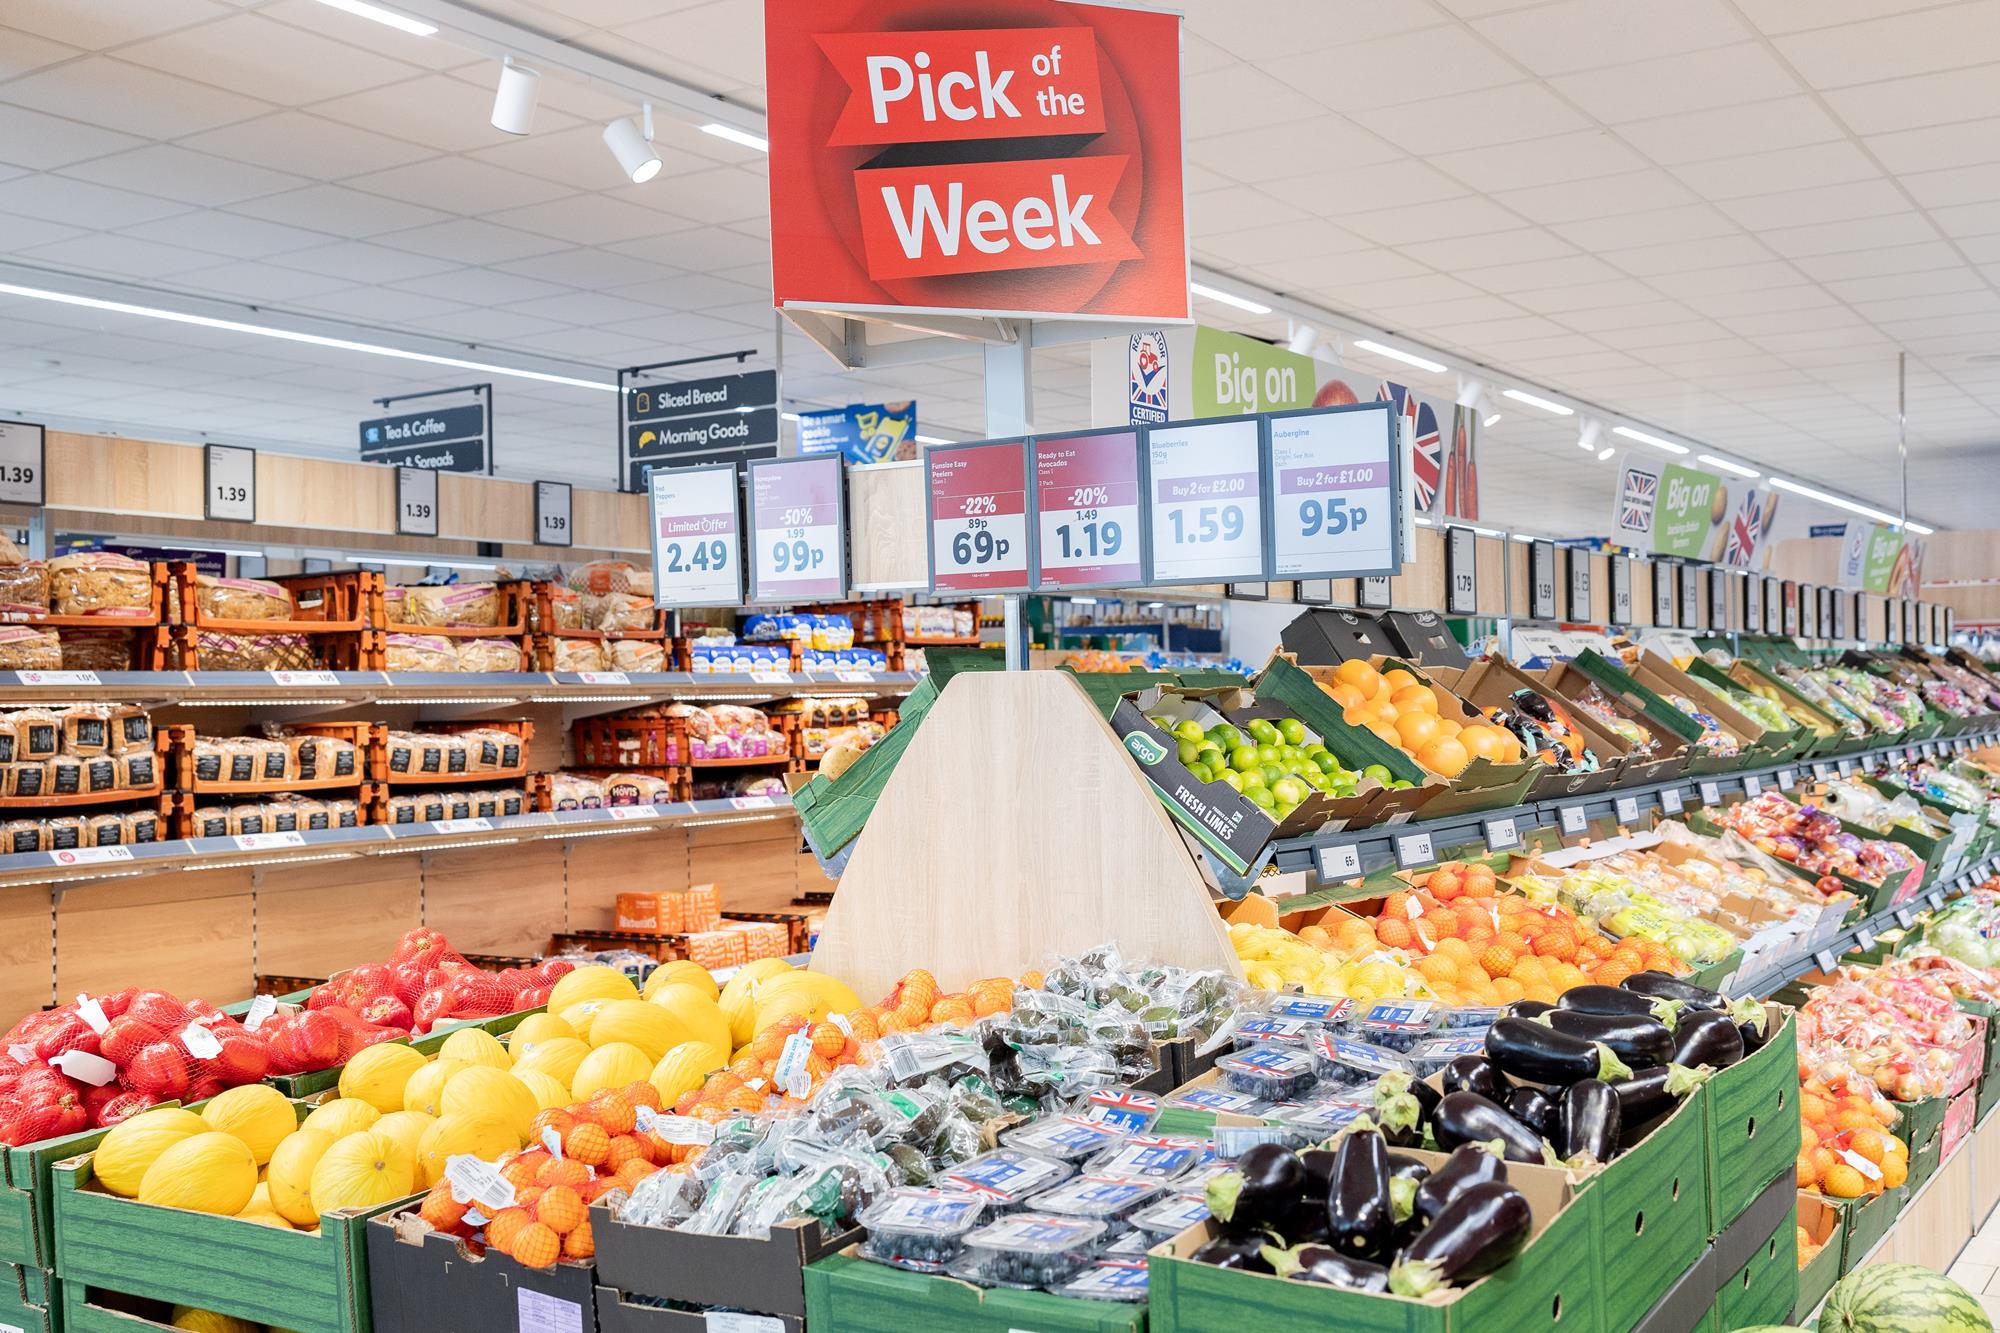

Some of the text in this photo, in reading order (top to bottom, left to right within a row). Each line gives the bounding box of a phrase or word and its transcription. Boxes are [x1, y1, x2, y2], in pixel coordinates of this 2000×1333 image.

[866, 45, 1062, 124] Pick of
[1036, 87, 1086, 117] the
[881, 174, 1102, 259] Week
[1215, 352, 1297, 414] Big on
[658, 385, 728, 409] Sliced Bread
[1132, 406, 1166, 423] CERTIFIED
[384, 419, 446, 440] Tea & Coffee
[659, 421, 749, 446] Morning Goods
[1273, 429, 1310, 439] Aubergine
[1152, 440, 1188, 449] Blueberries
[415, 451, 455, 469] Spreads
[1038, 451, 1057, 460] Ready
[1038, 460, 1067, 468] Avocados
[1152, 451, 1167, 459] 150g
[0, 466, 34, 483] 1.39
[932, 461, 967, 470] Funsize Easy
[932, 470, 953, 478] Peelers
[1296, 468, 1374, 487] Buy 2 for £1.00
[217, 486, 246, 501] 1.39
[1068, 486, 1108, 506] -20%
[1173, 478, 1245, 497] Buy 2 for £2.00
[1666, 477, 1710, 517] Big on
[405, 502, 430, 519] 1.39
[960, 495, 997, 515] -22%
[543, 514, 566, 531] 1.39
[779, 507, 813, 526] -50%
[968, 518, 988, 531] 89p
[1076, 509, 1098, 521] 1.49
[1168, 505, 1244, 544] 1.59
[1299, 498, 1368, 537] 95p
[668, 519, 700, 533] Limited
[787, 528, 805, 539] 1.99
[952, 530, 1010, 565] 69p
[1056, 521, 1122, 558] 1.19
[667, 539, 728, 573] 2.49
[773, 540, 824, 573] 99p
[1456, 575, 1472, 592] 1.79
[1539, 584, 1551, 599] 1.59
[1131, 738, 1156, 762] argo
[1174, 784, 1207, 817] FRESH
[1203, 810, 1235, 841] LIMES
[1418, 842, 1430, 855] 1.29
